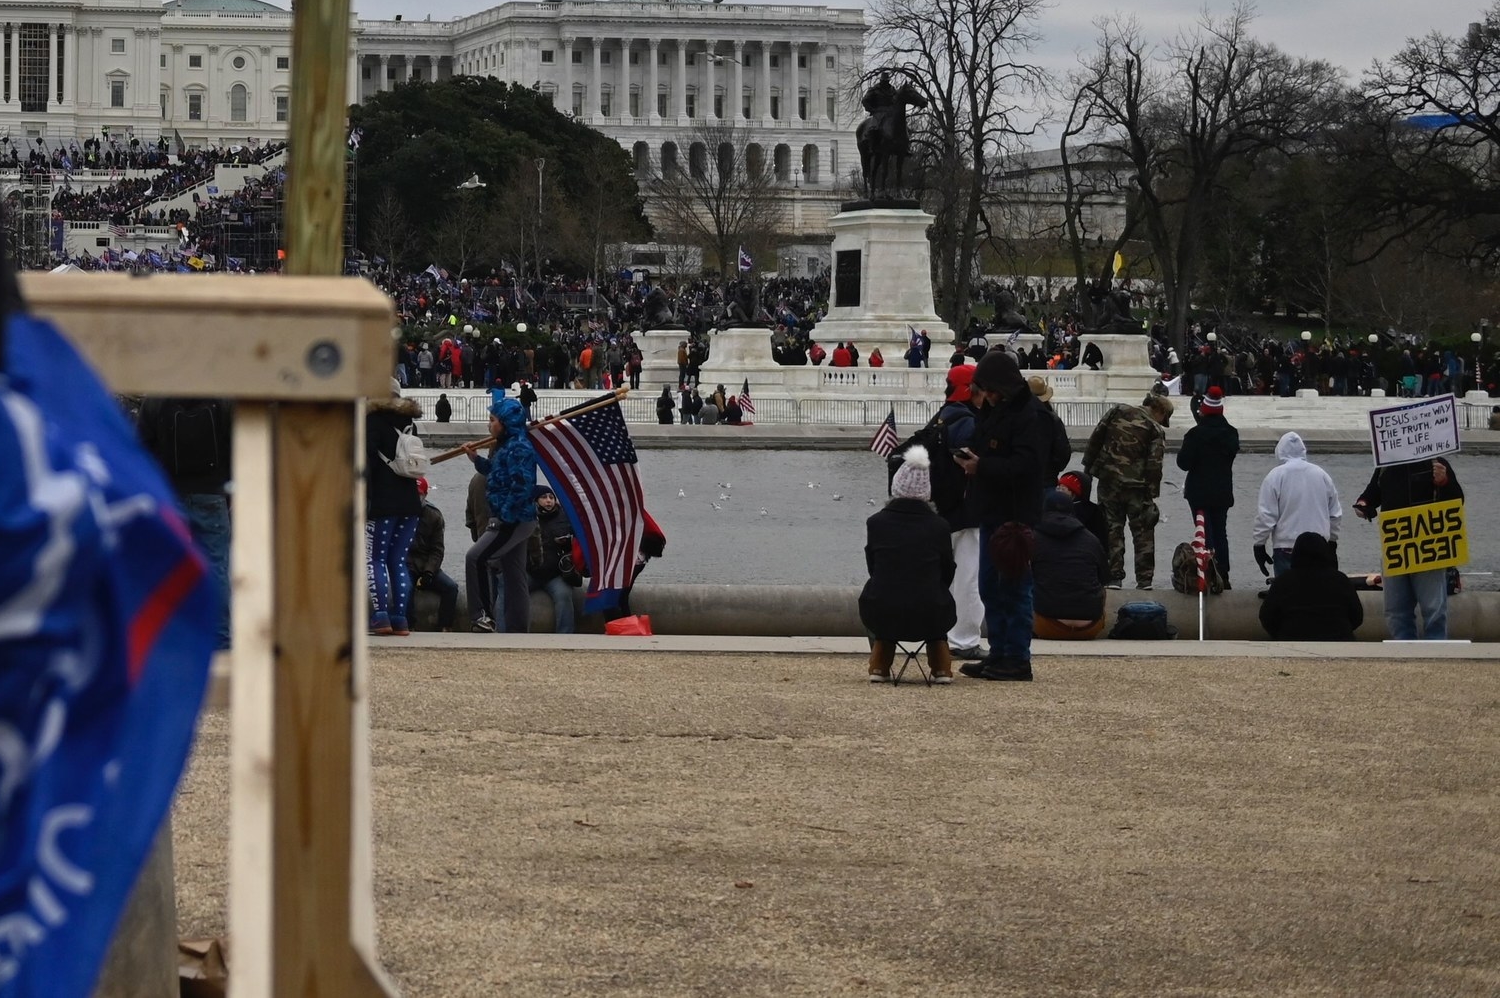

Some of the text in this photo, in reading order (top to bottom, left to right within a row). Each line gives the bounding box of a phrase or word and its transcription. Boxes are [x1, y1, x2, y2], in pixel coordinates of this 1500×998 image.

[1376, 413, 1410, 429] JESUS
[1432, 403, 1451, 416] WAY
[1379, 428, 1398, 440] THE
[1434, 417, 1449, 426] AND
[1381, 432, 1430, 452] THE LIFE
[1413, 444, 1433, 456] JOHN
[1382, 507, 1463, 544] SAVES
[1386, 534, 1463, 570] JESUS
